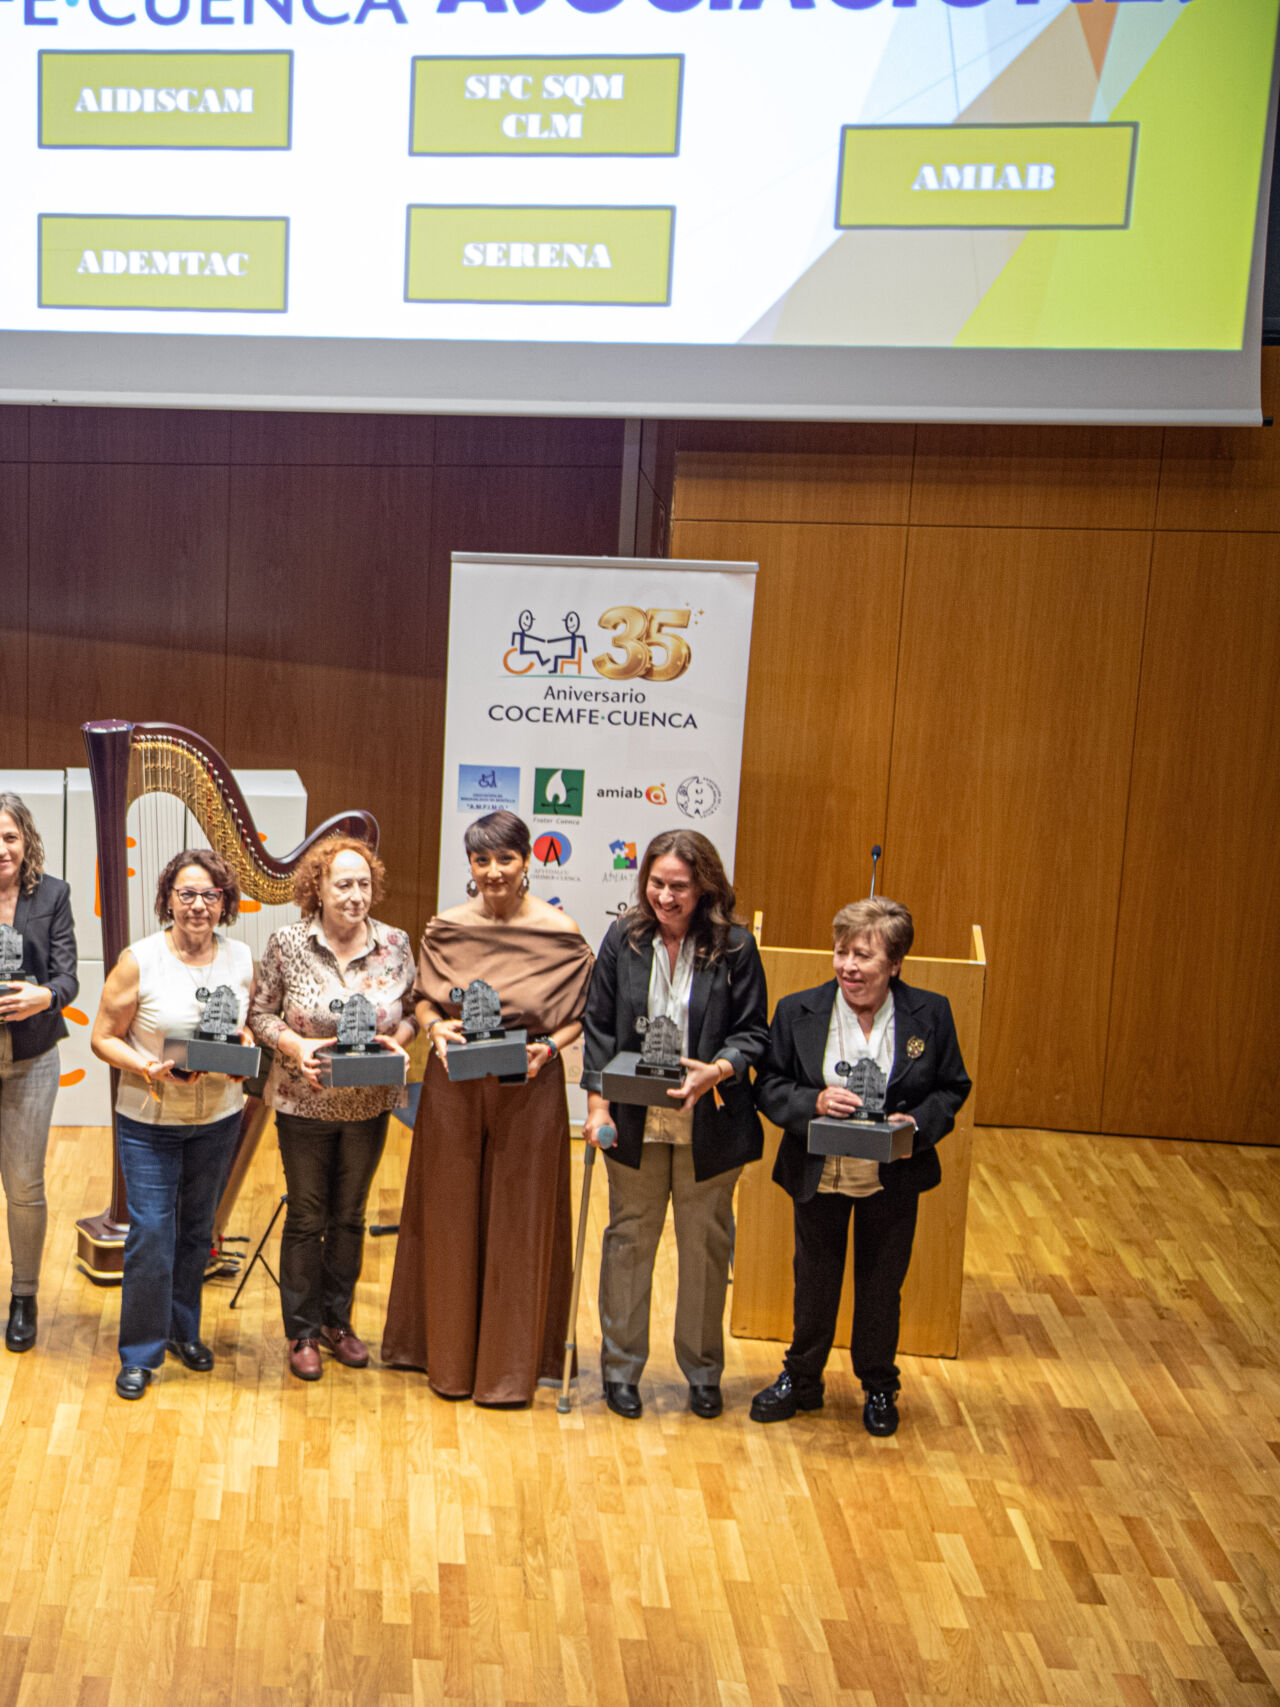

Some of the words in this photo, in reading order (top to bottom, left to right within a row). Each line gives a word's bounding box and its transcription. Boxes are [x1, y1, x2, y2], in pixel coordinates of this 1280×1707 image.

[74, 86, 254, 113] AIDISCAM
[464, 73, 533, 100] SFC
[542, 73, 625, 107] SQM
[502, 112, 584, 139] CLM
[911, 163, 1055, 191] AMIAB
[76, 248, 249, 276] ADEMTAC
[462, 241, 613, 269] SERENA
[592, 605, 692, 682] 35
[544, 685, 646, 704] Aniversario
[596, 786, 643, 799] amiab
